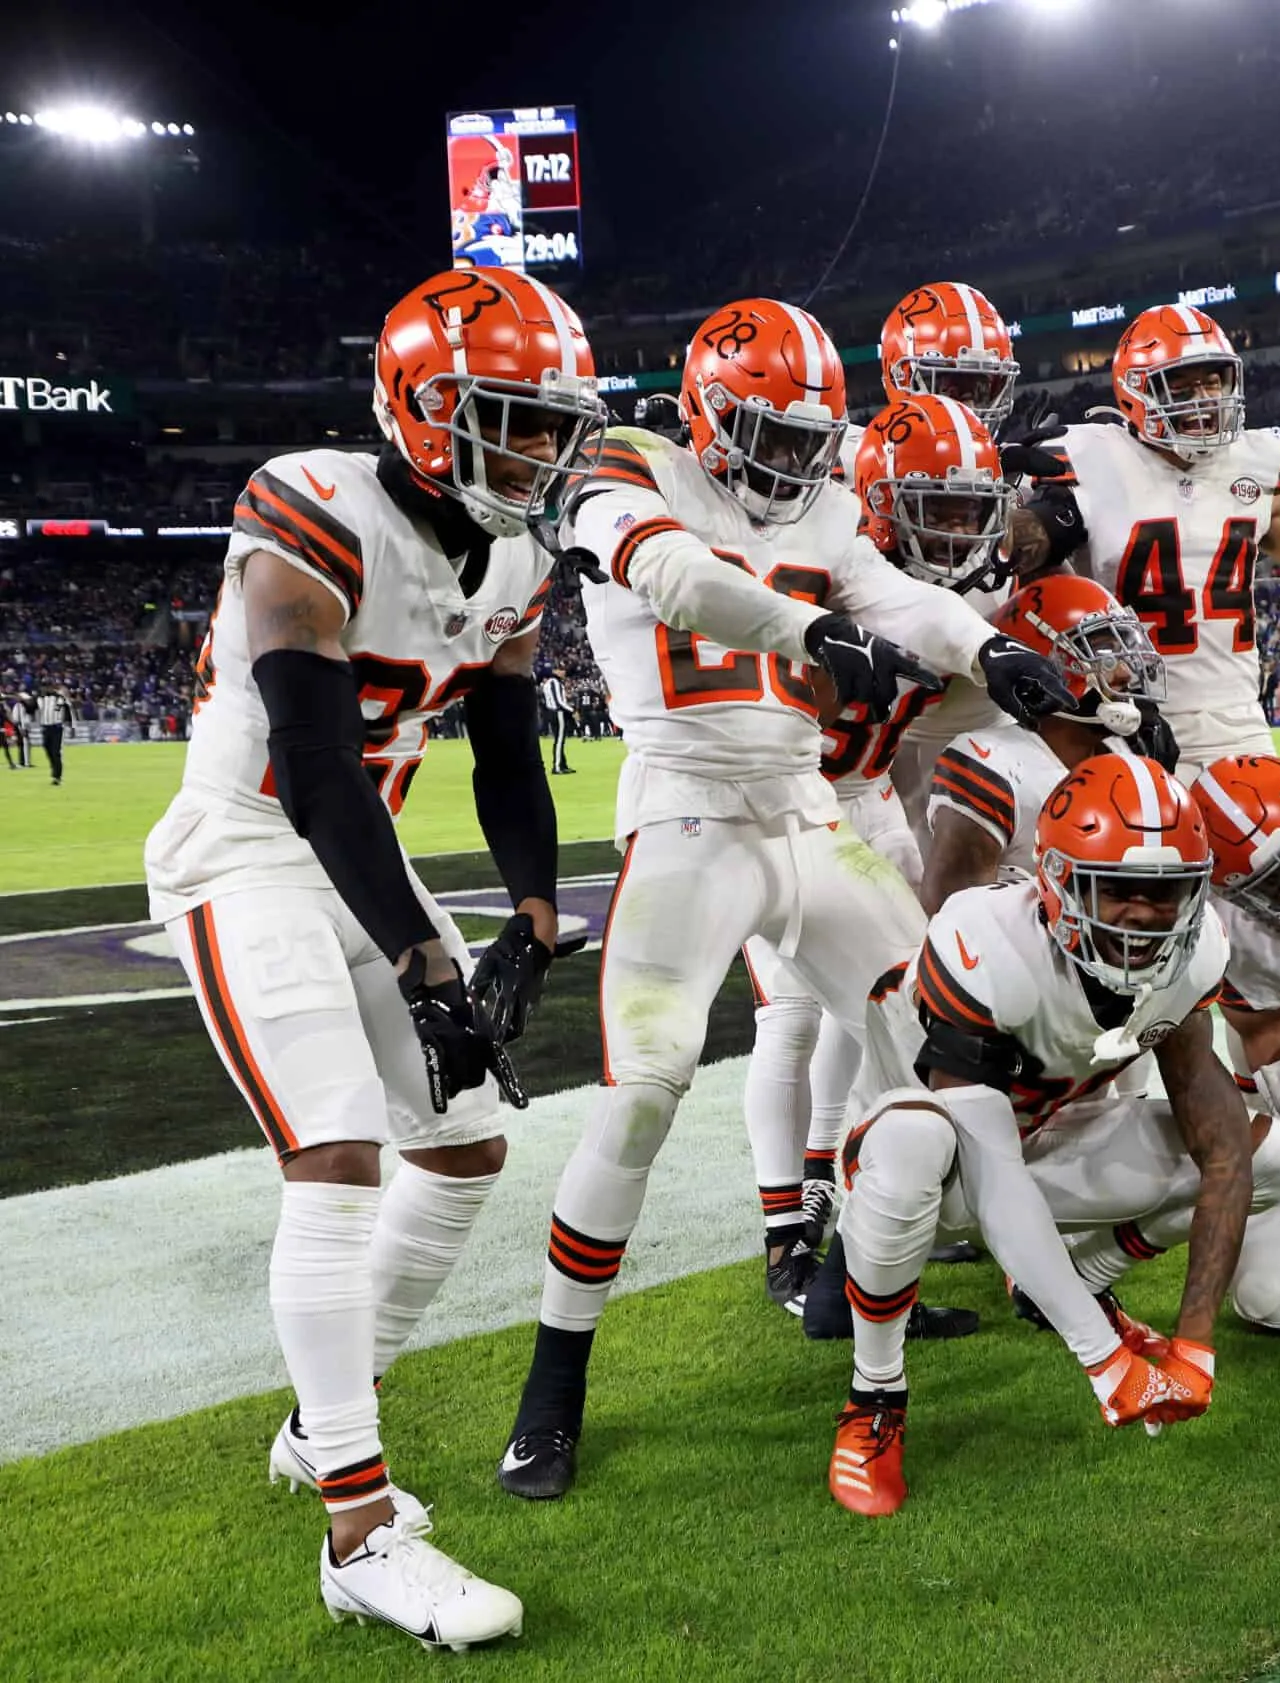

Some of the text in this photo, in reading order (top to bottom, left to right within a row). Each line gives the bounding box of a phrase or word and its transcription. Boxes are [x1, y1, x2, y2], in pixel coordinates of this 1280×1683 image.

[524, 153, 570, 182] 17:12
[524, 232, 578, 261] 29:04
[702, 310, 758, 360] 28
[1236, 483, 1258, 498] 1946
[1115, 516, 1258, 656] 44
